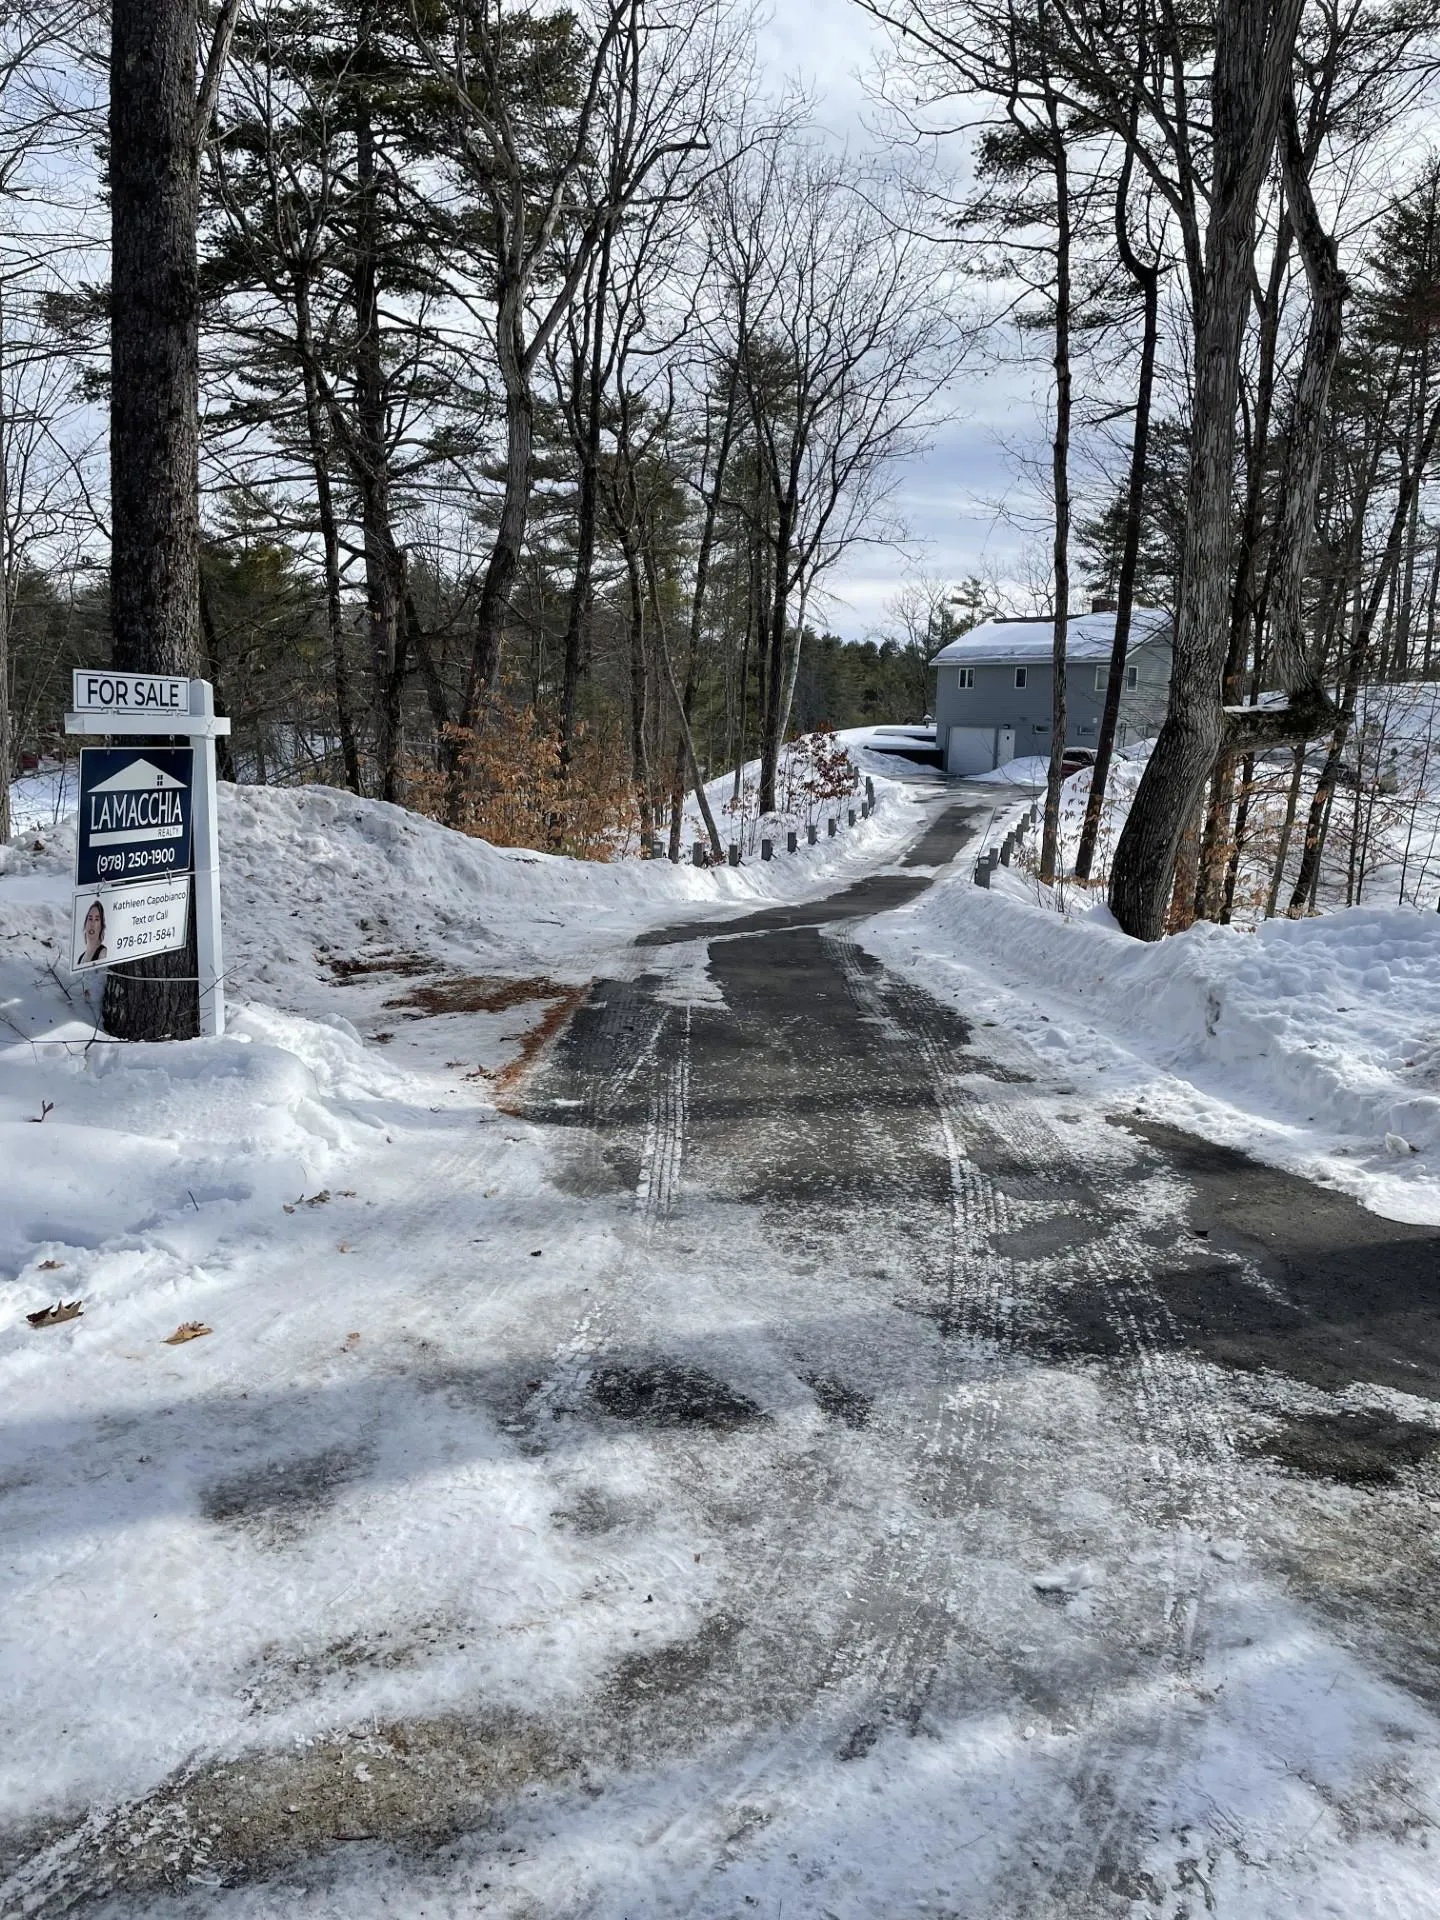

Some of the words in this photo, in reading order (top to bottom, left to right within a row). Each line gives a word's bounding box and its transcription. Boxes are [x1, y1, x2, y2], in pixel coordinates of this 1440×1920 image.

[87, 678, 128, 705] FOR
[134, 682, 179, 707] SALE
[90, 791, 183, 830] LAMACCHIA
[158, 827, 179, 838] REALTY
[97, 852, 125, 875] (978)
[128, 847, 175, 868] 250-1900
[113, 898, 145, 911] Kathleen
[147, 891, 186, 906] Capobianco
[132, 915, 147, 926] Text
[156, 910, 169, 921] Call
[117, 926, 175, 949] 978-621-5841
